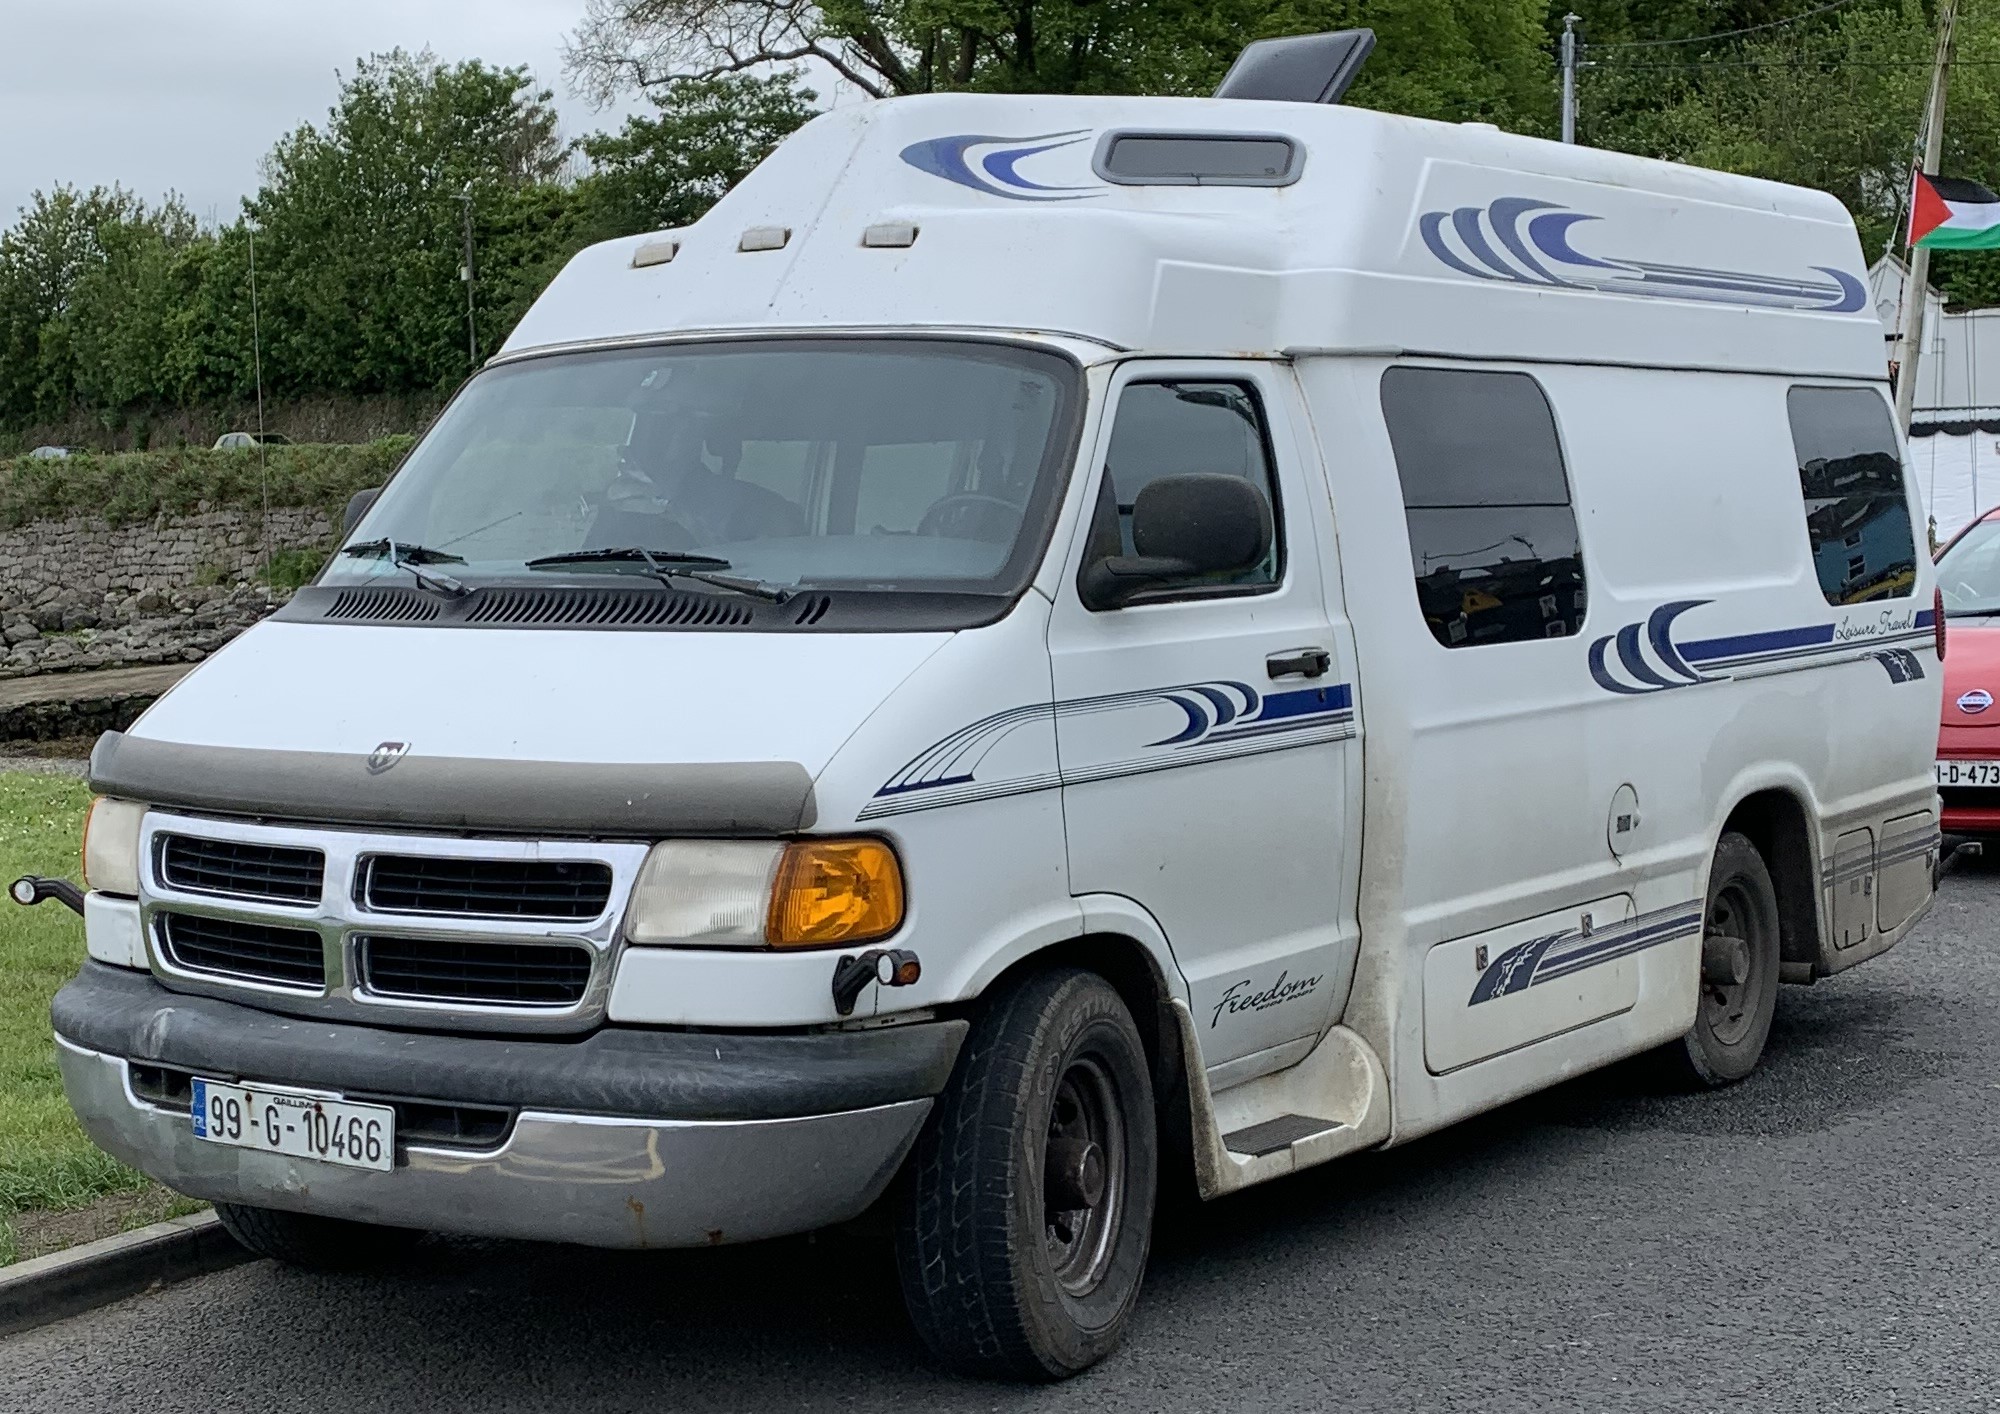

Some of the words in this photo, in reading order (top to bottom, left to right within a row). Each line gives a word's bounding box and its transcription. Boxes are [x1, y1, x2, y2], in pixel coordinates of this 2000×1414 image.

[1835, 616, 1876, 640] Leisure
[1879, 609, 1914, 635] Travel
[1934, 765, 2000, 784] 1-D-473
[1211, 969, 1324, 1029] Freedom
